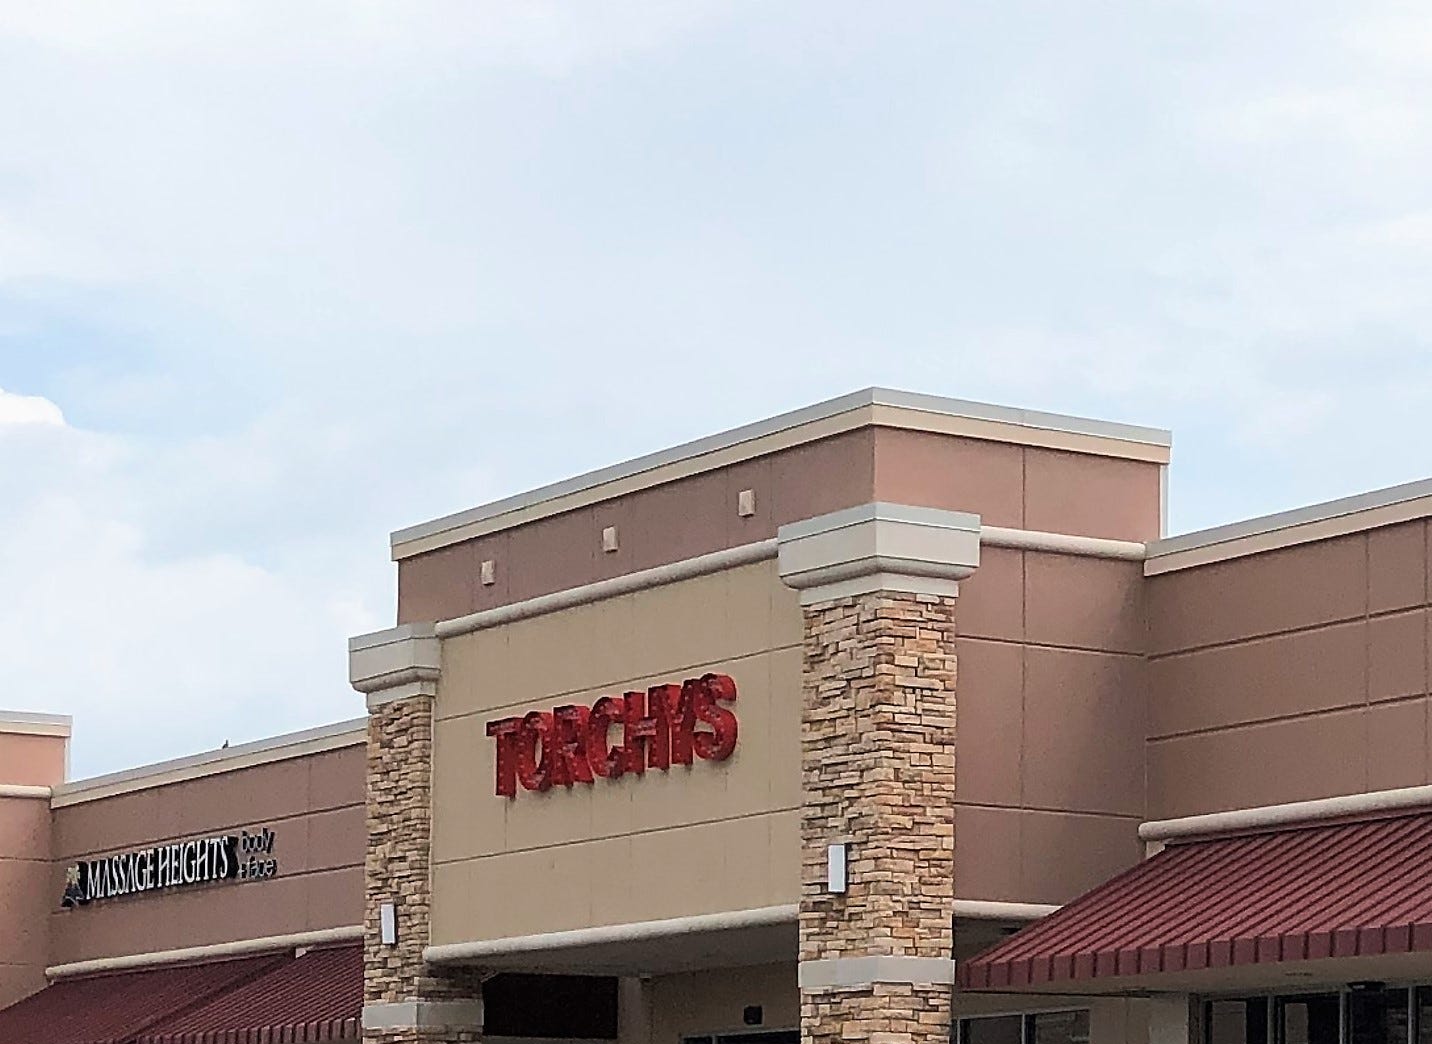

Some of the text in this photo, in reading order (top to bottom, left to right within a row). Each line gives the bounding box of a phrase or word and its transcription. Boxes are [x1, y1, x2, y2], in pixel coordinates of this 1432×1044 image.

[486, 673, 738, 799] TORCHYS
[85, 835, 230, 901] MASSAGE HEIGHTS
